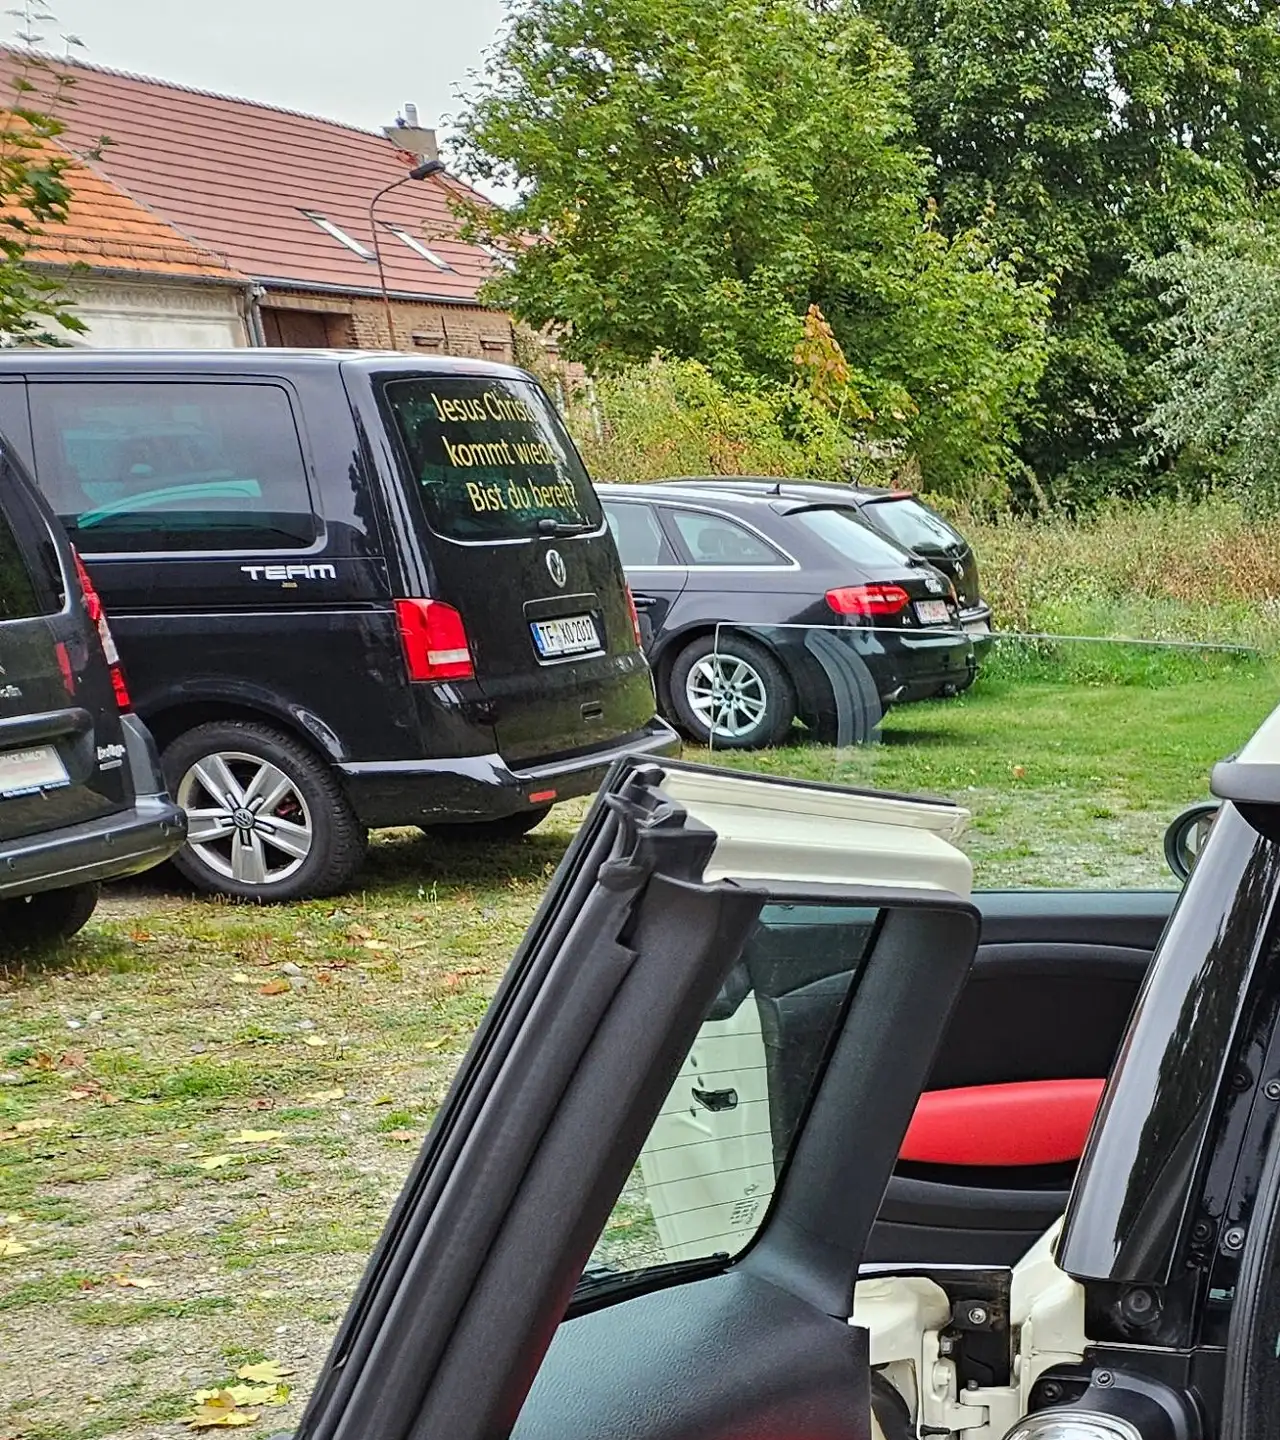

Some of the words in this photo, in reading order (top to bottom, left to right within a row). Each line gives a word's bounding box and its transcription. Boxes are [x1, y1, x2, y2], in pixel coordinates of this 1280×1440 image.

[431, 392, 487, 423] Jesus
[484, 390, 537, 424] Christ
[441, 435, 515, 468] kommt
[465, 479, 508, 512] Bist
[508, 478, 530, 510] du
[527, 477, 579, 508] bereit?
[240, 564, 337, 580] TEAM
[539, 625, 554, 648] TF
[572, 619, 595, 642] 2017
